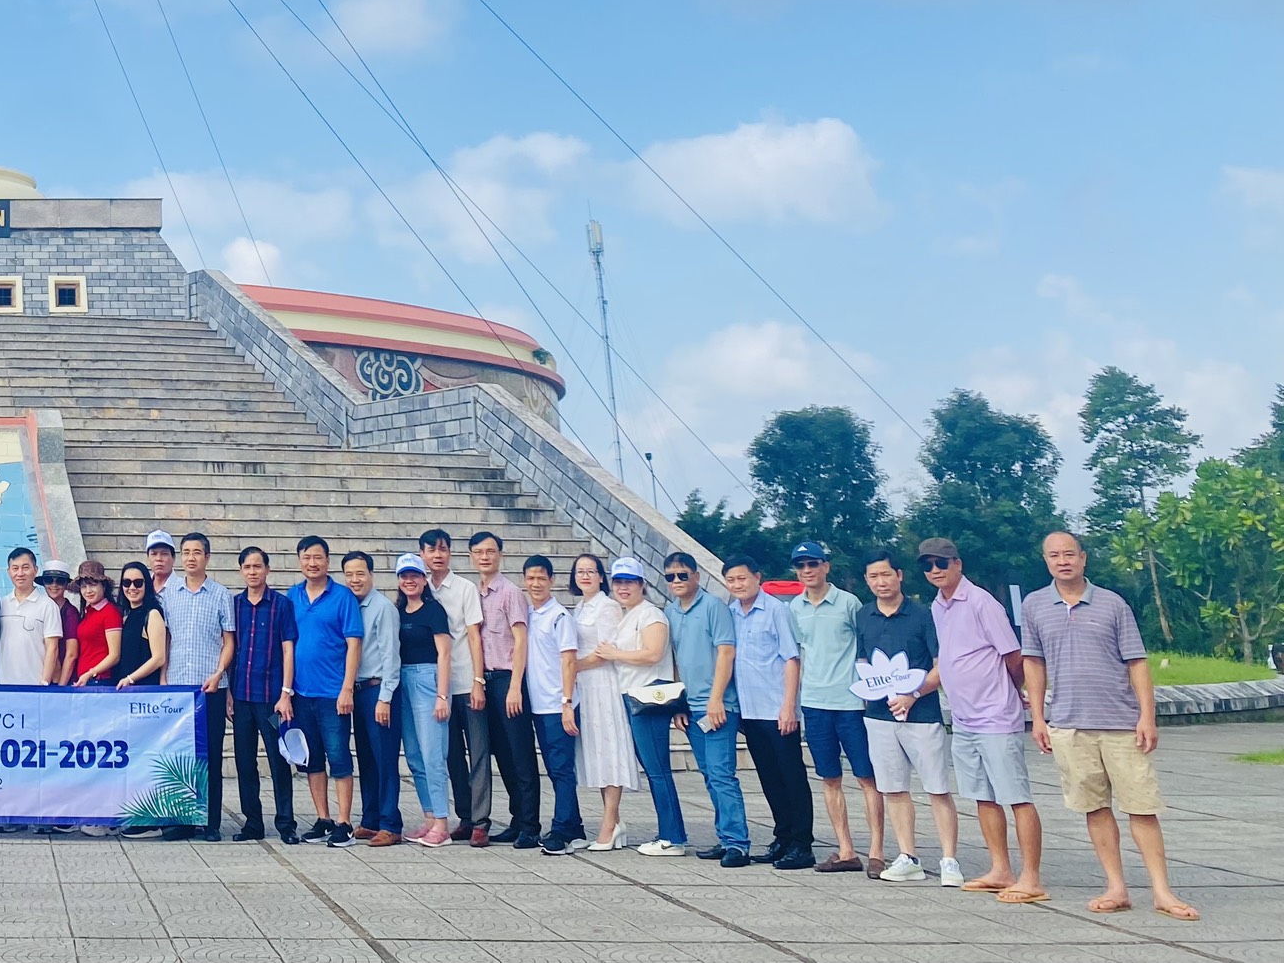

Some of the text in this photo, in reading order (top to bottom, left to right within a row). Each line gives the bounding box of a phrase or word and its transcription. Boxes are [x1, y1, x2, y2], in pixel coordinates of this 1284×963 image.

[866, 675, 892, 688] Elite
[129, 701, 185, 714] Elite Tour
[20, 713, 26, 730] I
